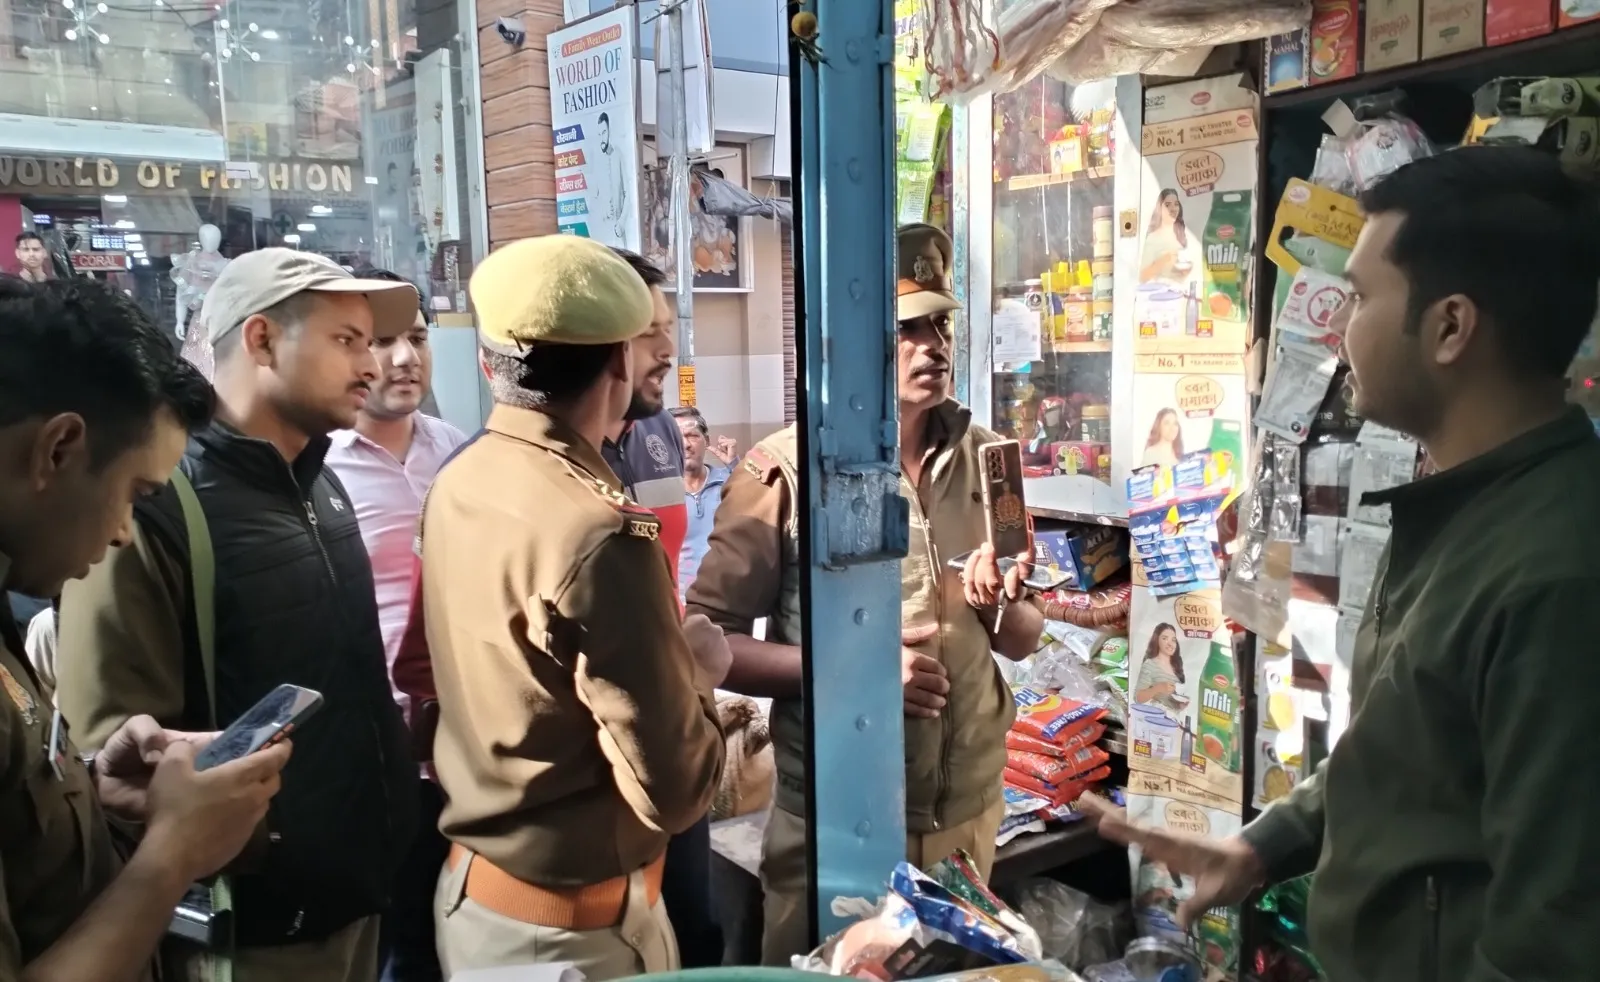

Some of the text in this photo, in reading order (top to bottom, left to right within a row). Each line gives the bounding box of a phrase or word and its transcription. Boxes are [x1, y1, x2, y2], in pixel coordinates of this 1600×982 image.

[1273, 41, 1299, 55] MAHAL
[555, 46, 623, 88] WORLD OF
[563, 78, 617, 114] FASHION
[556, 128, 577, 144] शेरवानी
[1157, 128, 1185, 149] No. 1
[1185, 155, 1211, 172] डबल
[137, 160, 182, 188] OF
[1181, 167, 1218, 185] धमाका
[79, 255, 118, 267] CORAL
[1207, 242, 1239, 265] Mili
[1158, 355, 1185, 368] No. 1
[1183, 603, 1208, 614] डबल
[1179, 615, 1215, 627] धमाका
[1203, 687, 1232, 714] Mili
[1049, 715, 1066, 732] FREE
[1135, 744, 1150, 754] FREE
[1191, 754, 1205, 766] FREE
[1143, 780, 1164, 792] No.
[1164, 779, 1172, 793] 1
